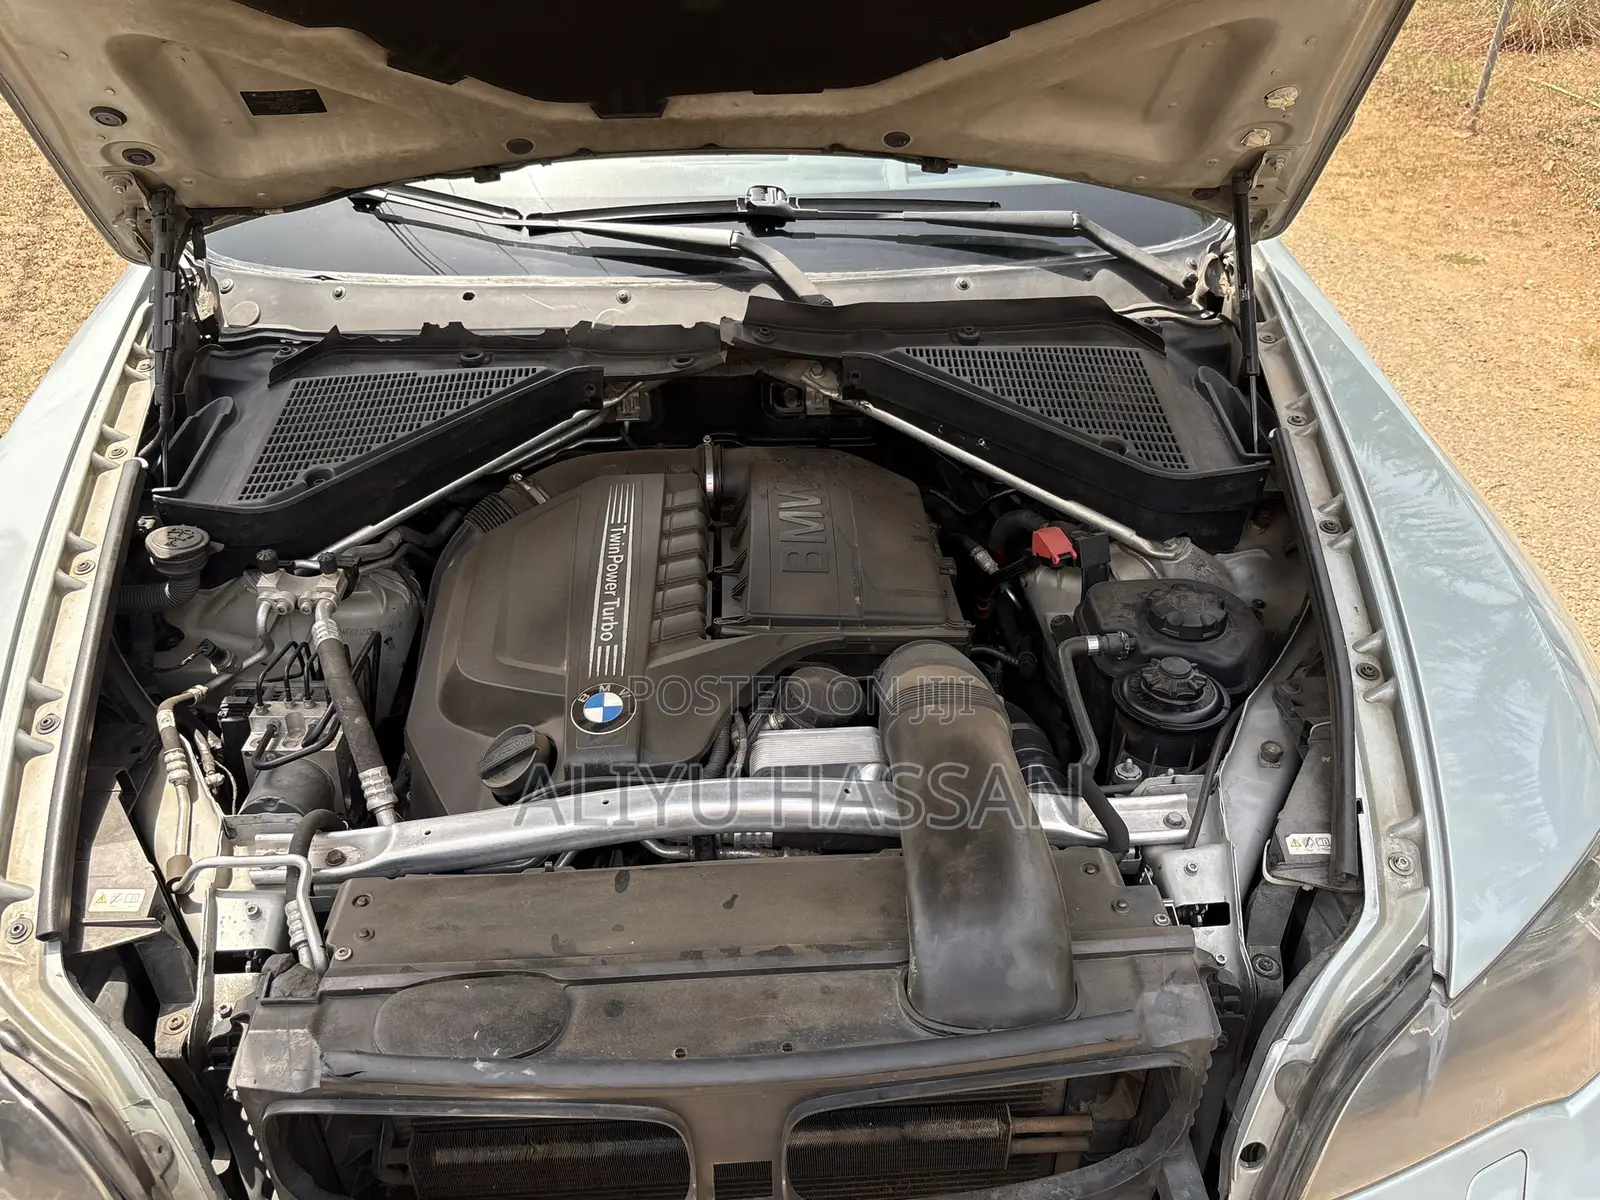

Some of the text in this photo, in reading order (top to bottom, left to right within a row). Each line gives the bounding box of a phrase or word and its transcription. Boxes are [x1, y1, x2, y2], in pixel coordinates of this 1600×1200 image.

[777, 482, 830, 573] BMW
[600, 525, 627, 642] TwinPower Turbo
[578, 684, 632, 703] BMW
